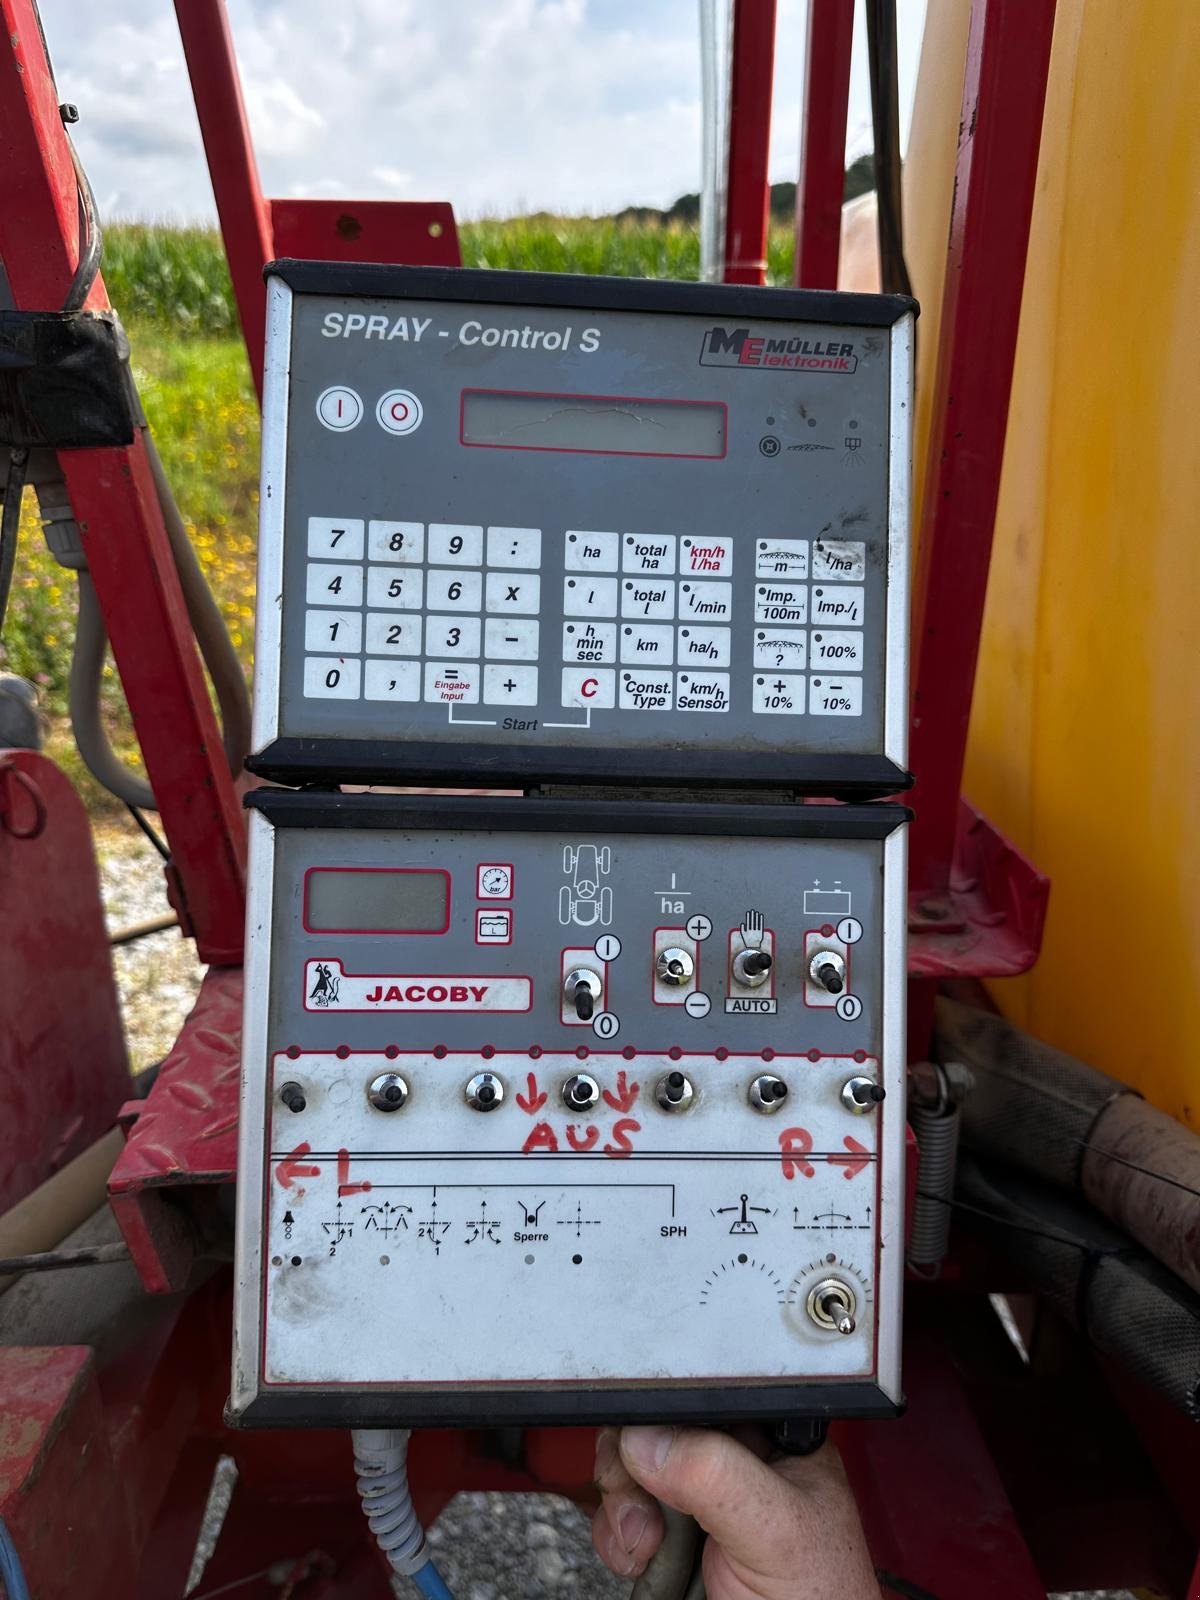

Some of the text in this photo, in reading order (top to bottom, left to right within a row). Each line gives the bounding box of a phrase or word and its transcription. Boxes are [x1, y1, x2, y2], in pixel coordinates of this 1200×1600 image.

[321, 312, 432, 342] SPRAY
[458, 321, 572, 350] Control
[579, 328, 600, 352] S
[766, 338, 854, 357] MÜLLER
[330, 529, 345, 548] 7
[389, 533, 404, 551] 8
[448, 536, 463, 554] 9
[583, 546, 600, 558] ha
[634, 545, 667, 557] total
[690, 546, 725, 558] km/h
[641, 556, 659, 569] ha
[691, 559, 721, 571] l/ha
[775, 562, 787, 573] m
[327, 576, 342, 595] 4
[387, 579, 403, 597] 5
[447, 582, 462, 600] 6
[633, 590, 666, 602] total
[766, 590, 796, 603] Imp.
[689, 594, 726, 615] l/min
[763, 607, 801, 620] 100m
[328, 622, 340, 641] 1
[386, 625, 402, 644] 2
[446, 627, 461, 646] 3
[586, 625, 595, 637] h
[576, 638, 604, 650] min
[637, 638, 658, 651] km
[689, 641, 719, 659] ha/h
[577, 650, 603, 661] sec
[819, 645, 857, 659] 100%
[775, 654, 784, 666] ?
[325, 669, 340, 688] 0
[434, 681, 470, 691] Eingabe
[580, 678, 599, 698] C
[625, 681, 672, 694] Const.
[690, 683, 724, 700] km/h
[440, 691, 464, 701] Input
[632, 694, 666, 708] Type
[764, 696, 793, 709] 10%
[677, 696, 728, 710] Sensor
[823, 698, 851, 711] 10%
[502, 718, 538, 731] Start
[661, 898, 685, 914] ha
[366, 985, 489, 1003] JACOBY
[732, 1000, 771, 1012] AUTO
[521, 1118, 642, 1159] AUS
[778, 1127, 815, 1180] R
[337, 1148, 372, 1197] L
[348, 1229, 352, 1237] 1
[418, 1228, 424, 1237] 2
[514, 1231, 549, 1242] Sperre
[660, 1226, 688, 1238] SPH
[329, 1248, 336, 1256] 2
[435, 1248, 439, 1256] 1
